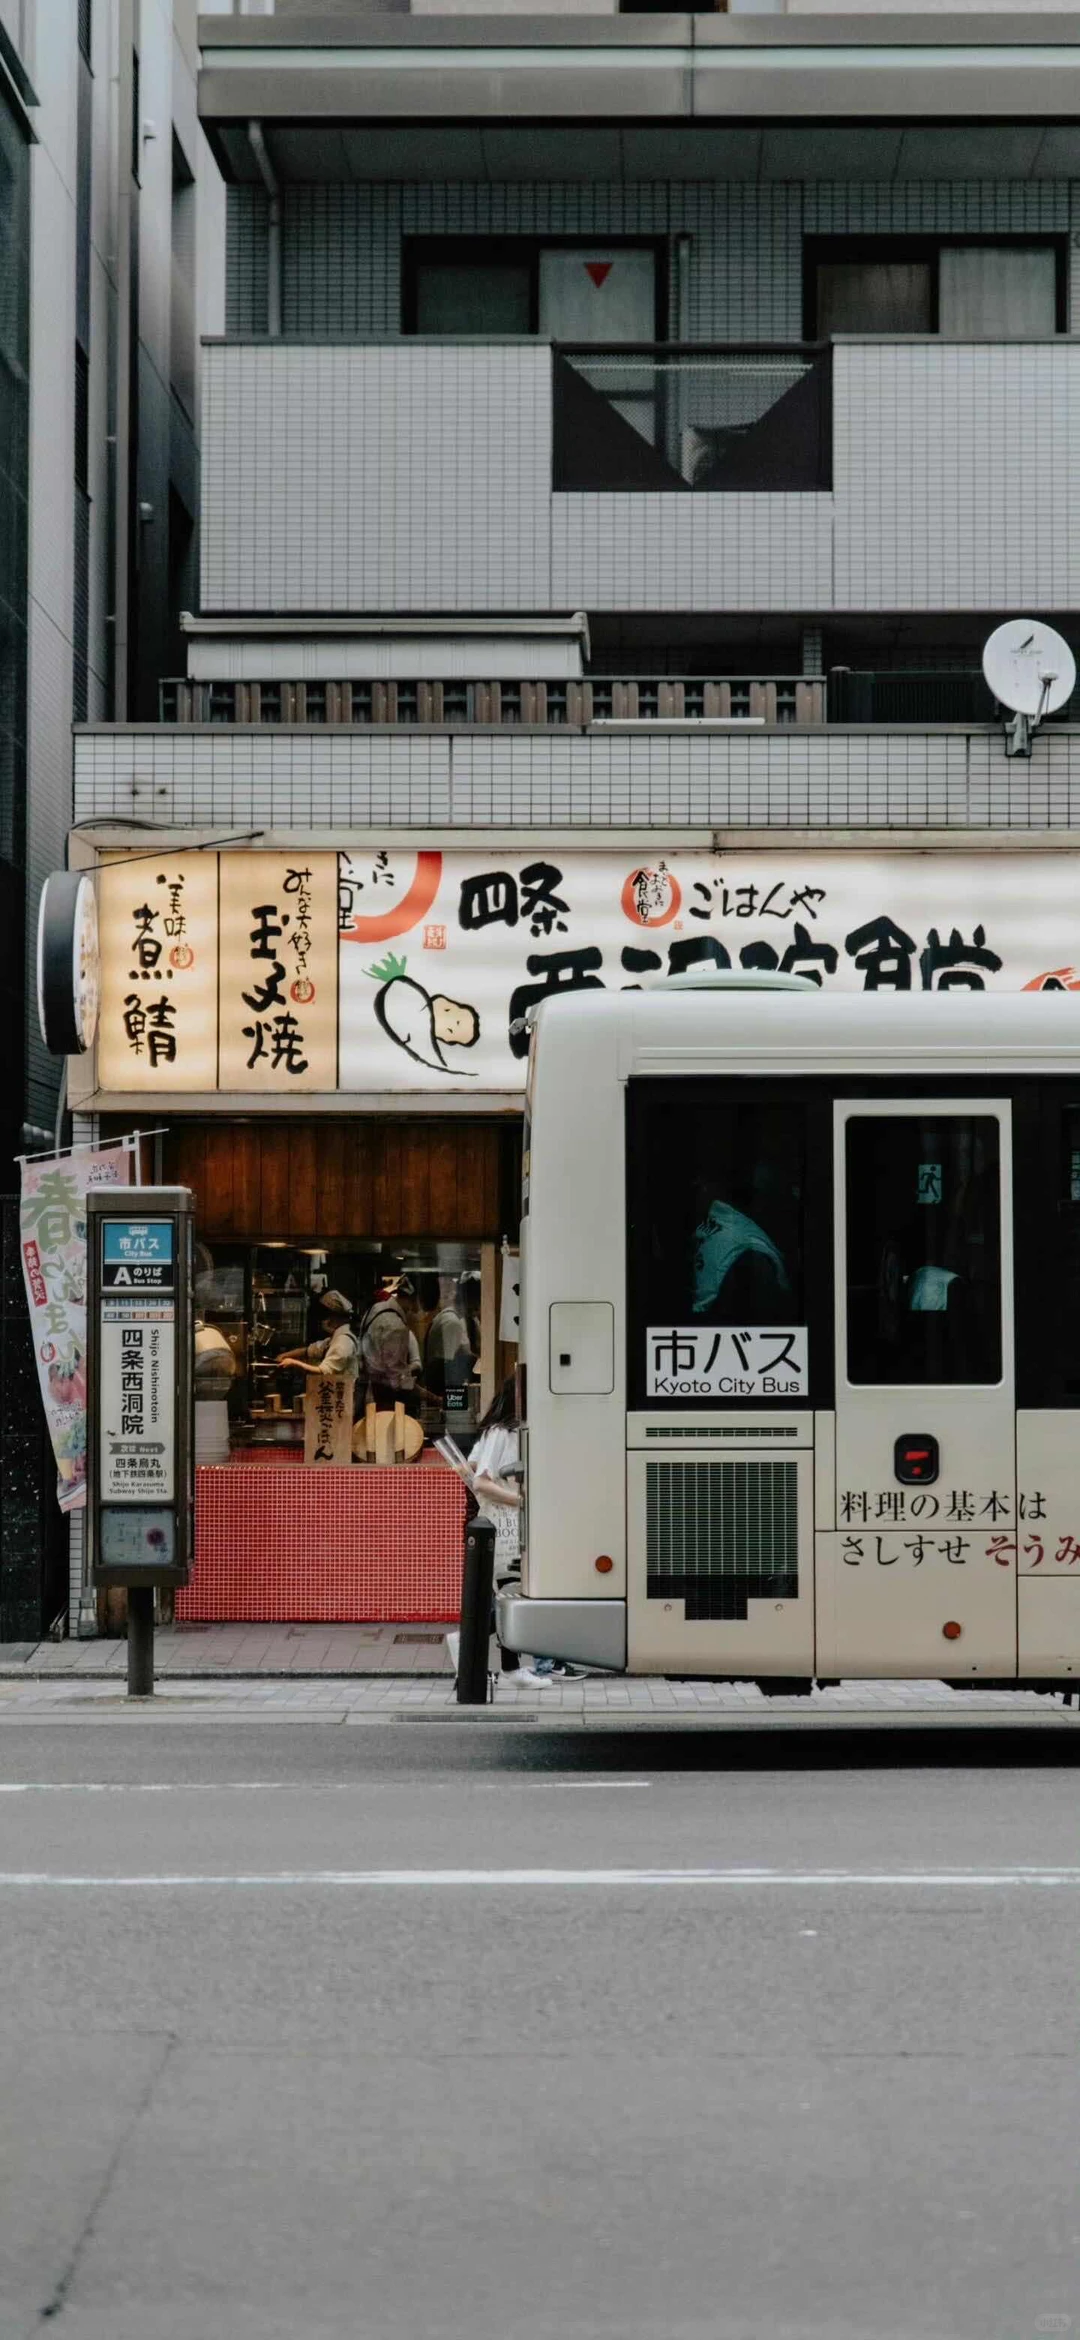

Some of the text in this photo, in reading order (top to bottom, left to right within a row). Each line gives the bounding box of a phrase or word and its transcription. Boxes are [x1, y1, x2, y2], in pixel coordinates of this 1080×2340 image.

[459, 862, 571, 938] 四条
[631, 870, 653, 924] 食堂
[689, 877, 826, 919] ごはんや
[282, 867, 313, 975] みんな大好き
[123, 904, 177, 1068] 煮鯖
[241, 905, 309, 1075] 玉子焼
[119, 1237, 160, 1250] 市バス
[113, 1266, 132, 1285] A
[133, 1267, 162, 1277] のりば
[651, 1329, 802, 1377] 市バス
[121, 1329, 144, 1436] 四条西洞院
[149, 1329, 160, 1423] Shijo Nishinotoin
[654, 1377, 800, 1395] Kyoto City Bus
[115, 1458, 161, 1468] 四条烏丸
[840, 1490, 1047, 1523] 料理の基本は
[841, 1534, 1080, 1568] さしすせ そうみ
